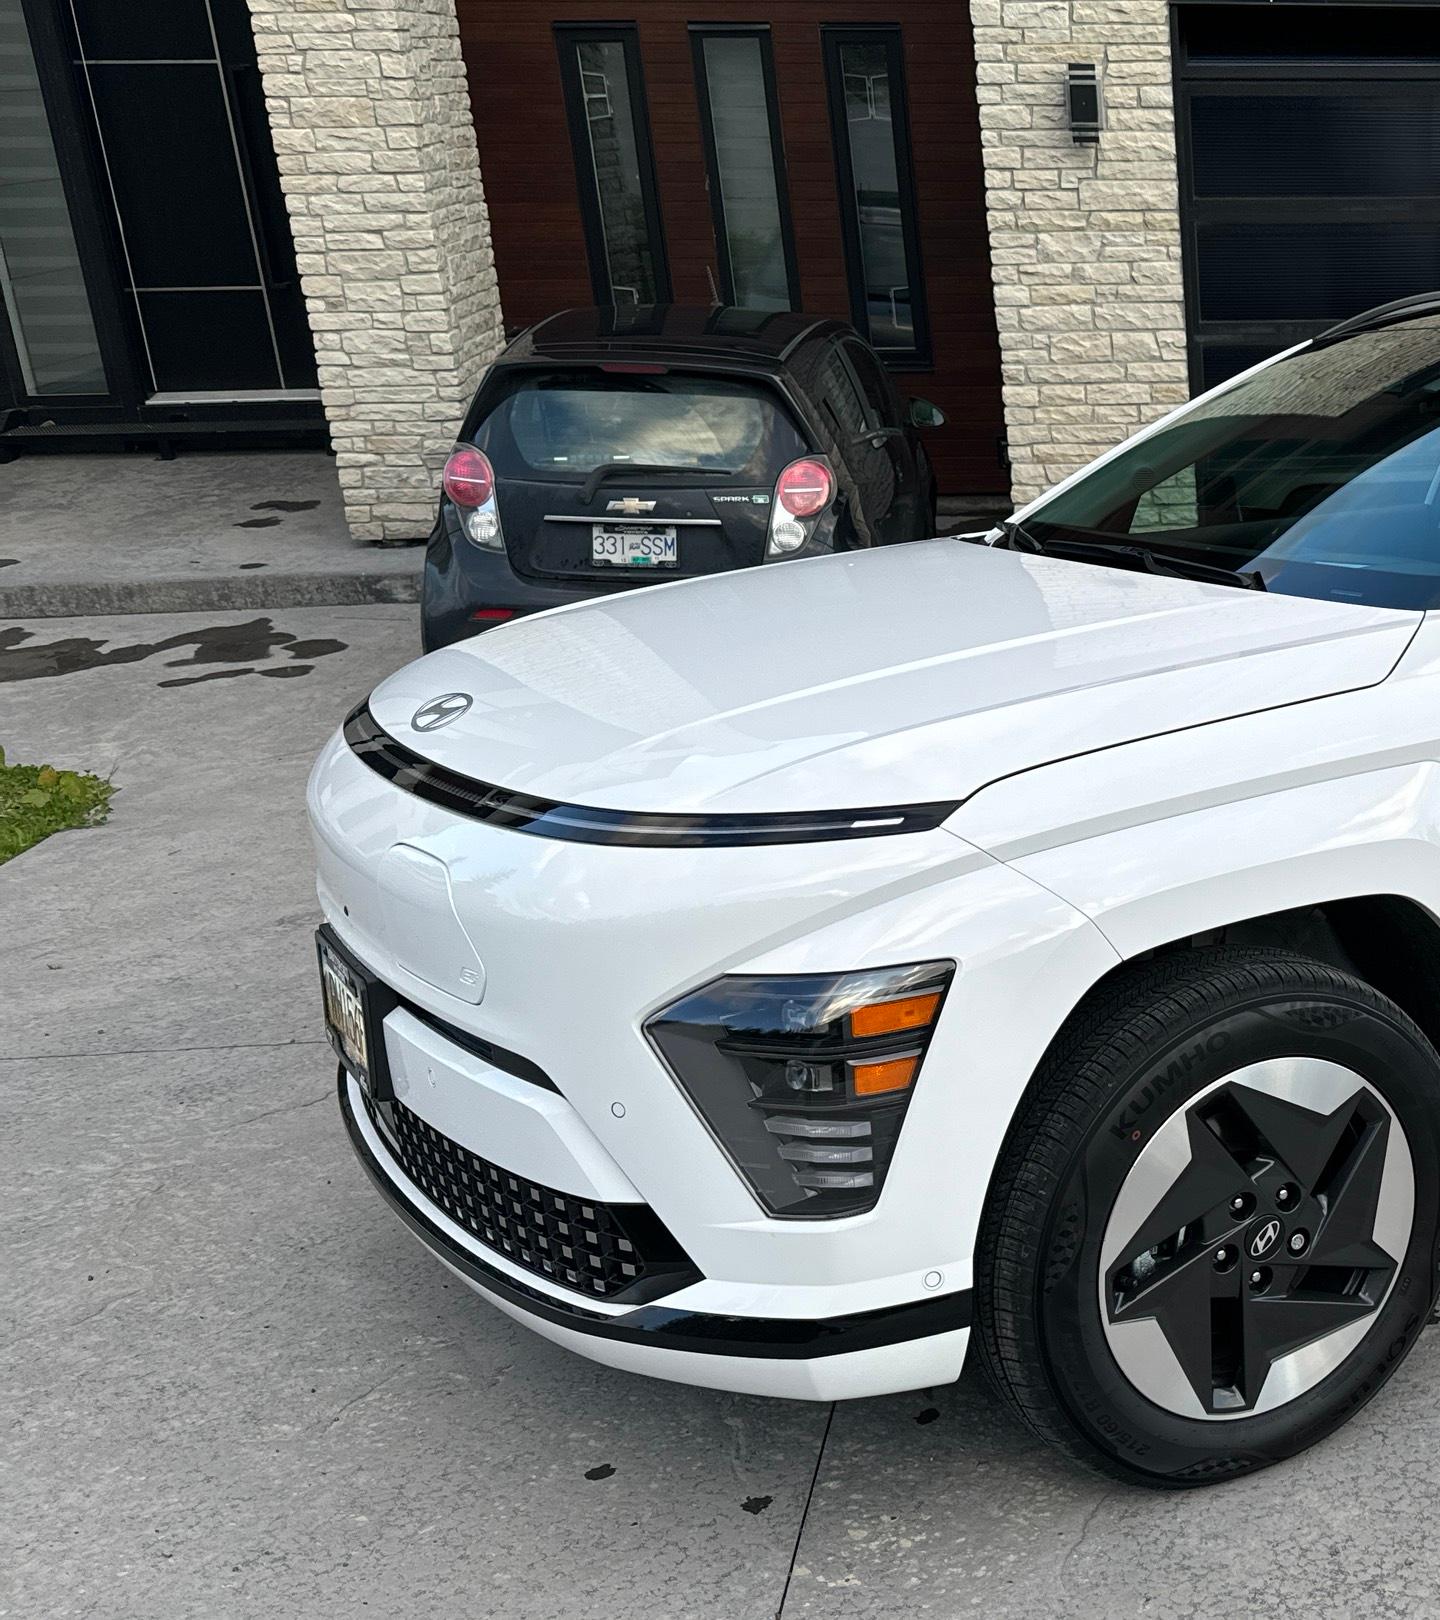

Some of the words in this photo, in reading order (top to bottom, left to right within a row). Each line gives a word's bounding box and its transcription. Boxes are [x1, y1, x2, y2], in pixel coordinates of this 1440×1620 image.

[594, 535, 625, 555] 331
[641, 536, 676, 557] SSM
[1108, 1031, 1232, 1140] KUMHO
